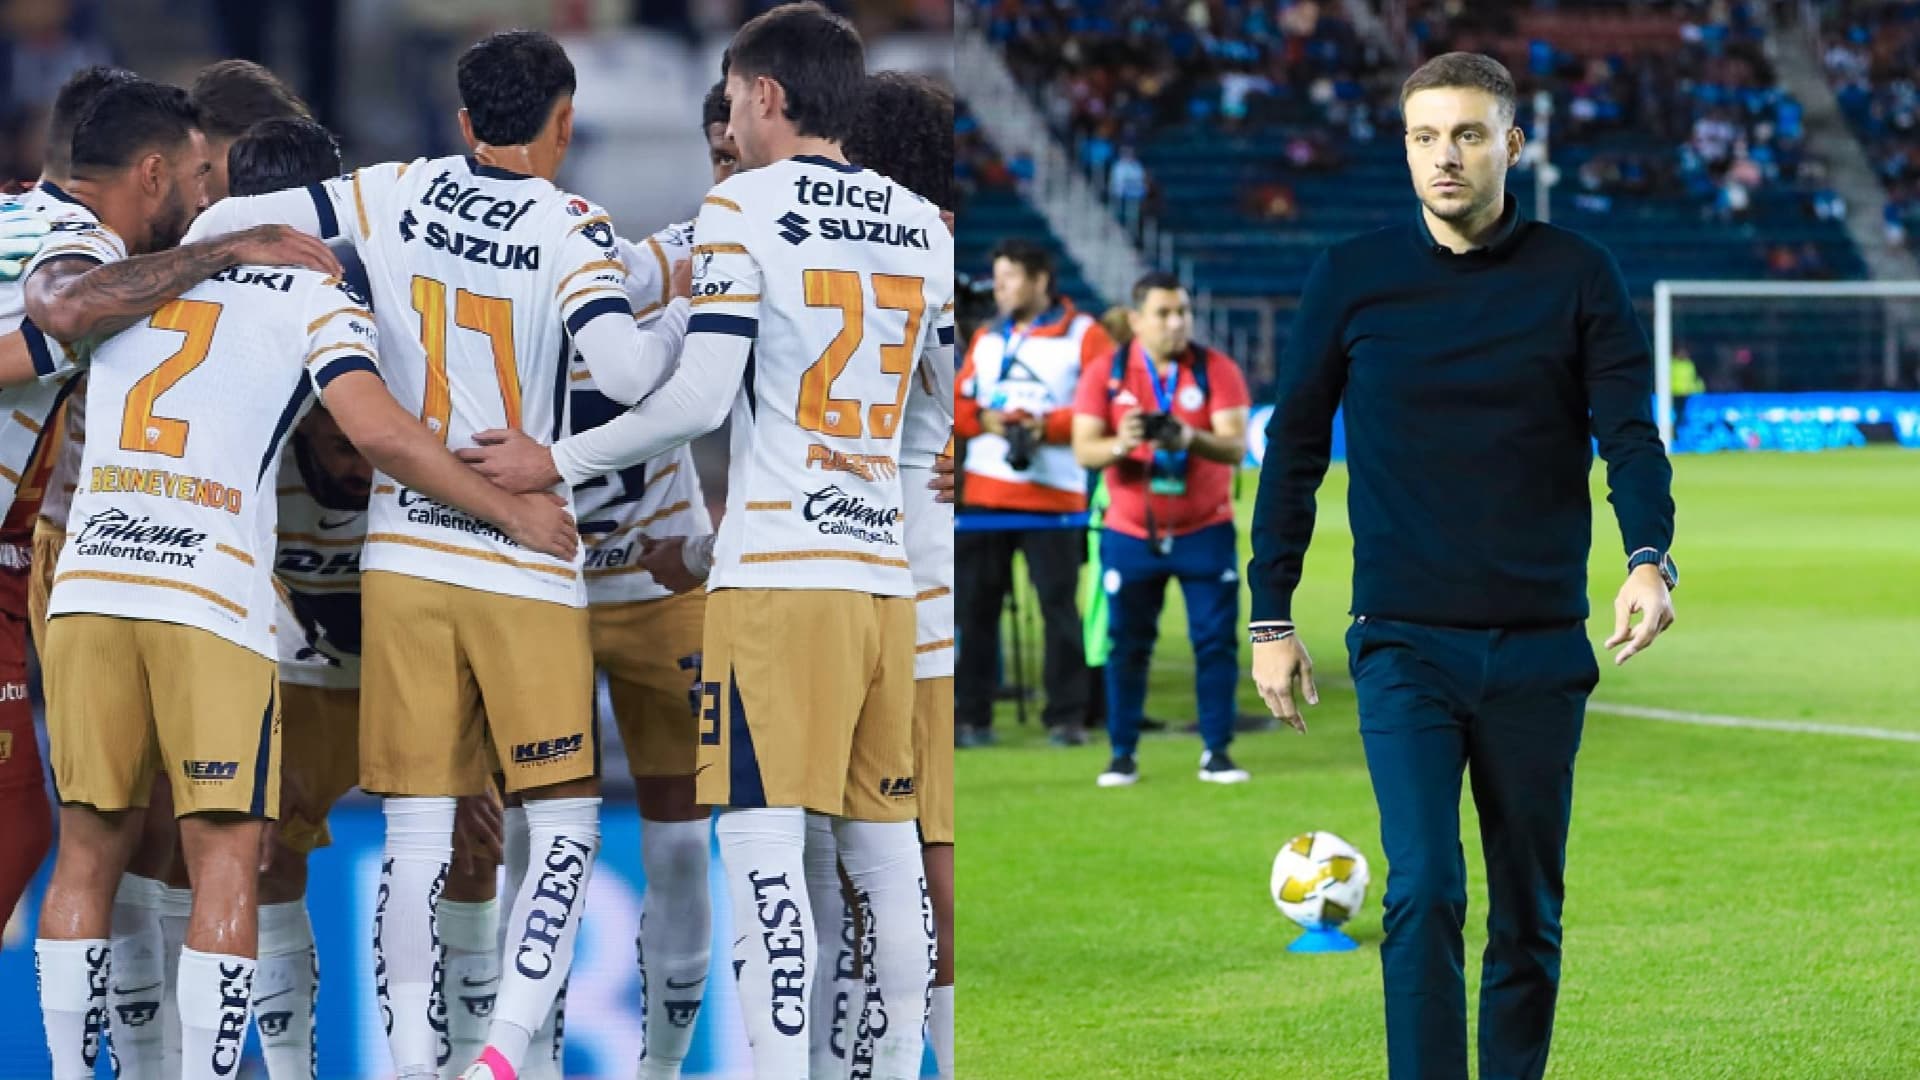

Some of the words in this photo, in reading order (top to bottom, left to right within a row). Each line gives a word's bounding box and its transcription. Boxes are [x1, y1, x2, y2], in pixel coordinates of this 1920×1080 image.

[420, 168, 537, 232] telcel
[793, 175, 893, 215] telcel
[423, 221, 540, 271] SUZUKI
[818, 217, 931, 250] SUZUKI
[119, 298, 224, 458] 2
[411, 274, 523, 446] 17
[795, 268, 926, 440] 23
[90, 464, 242, 515] BENNEVENDO
[77, 540, 196, 568] caliente.mx
[511, 732, 584, 763] KEM
[515, 834, 592, 981] CREST
[748, 869, 805, 1037] CREST
